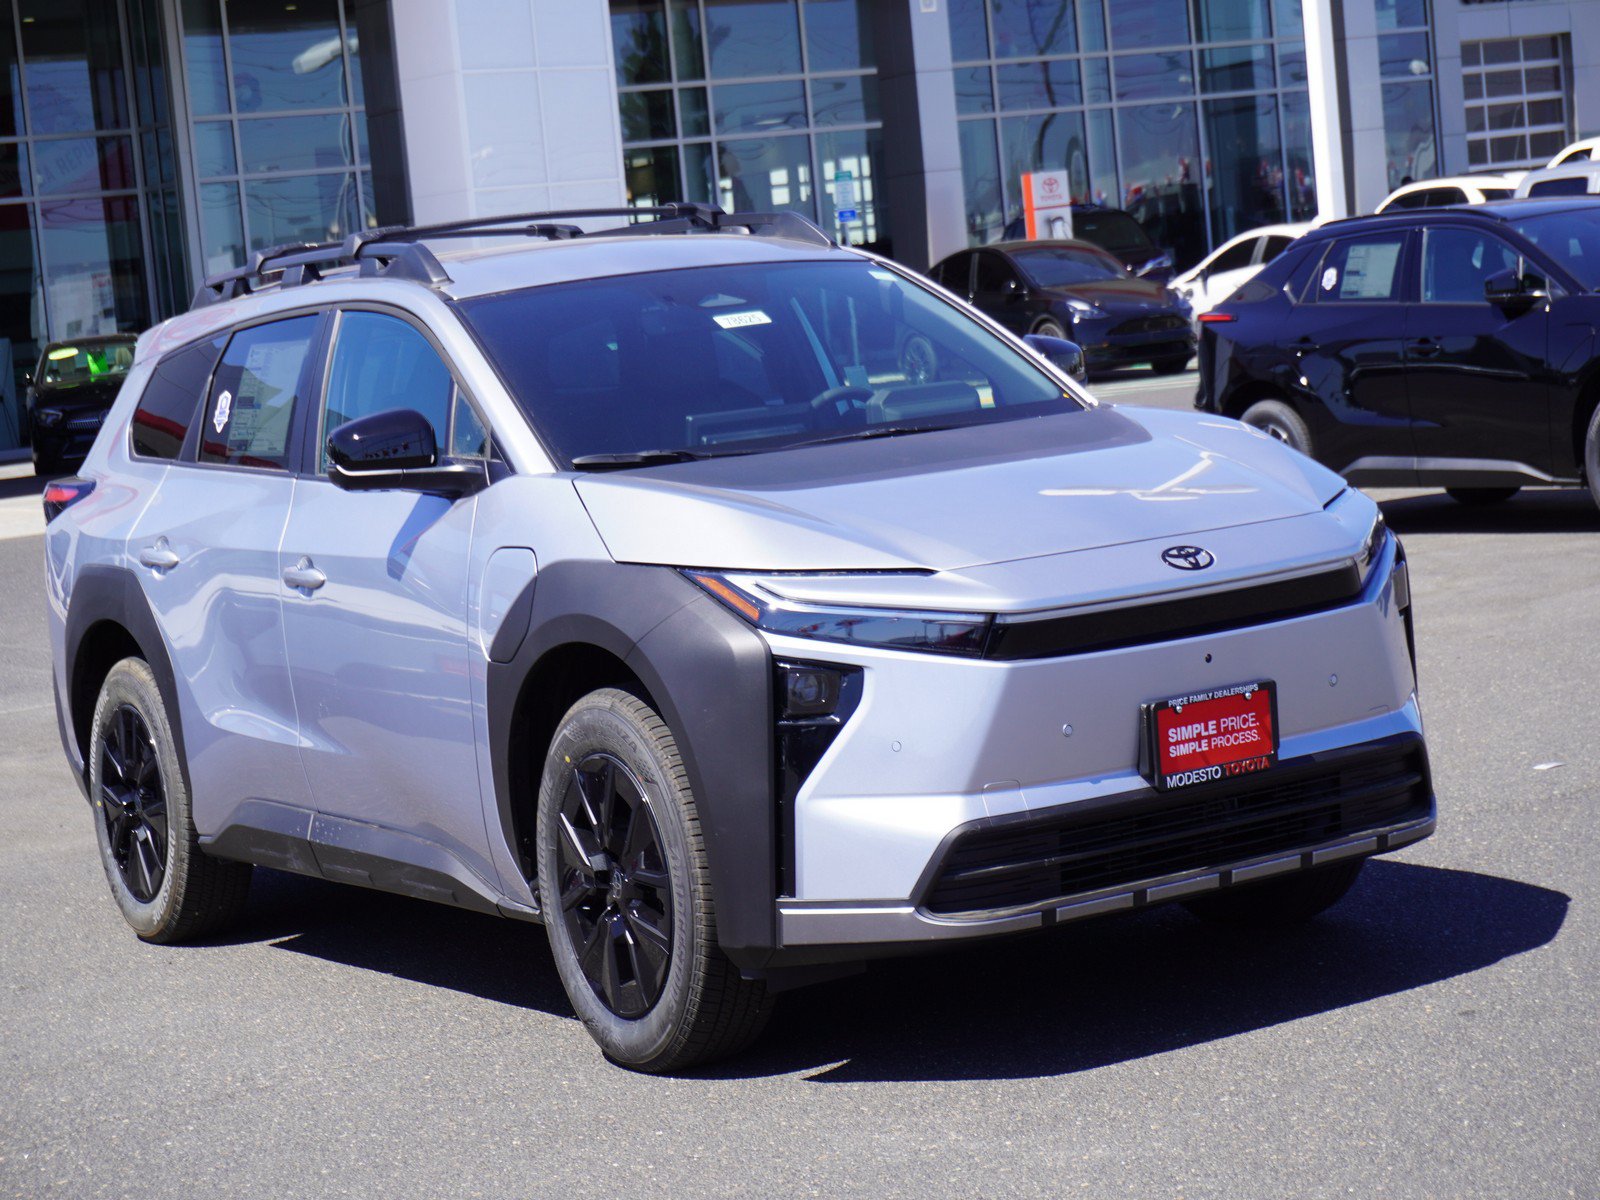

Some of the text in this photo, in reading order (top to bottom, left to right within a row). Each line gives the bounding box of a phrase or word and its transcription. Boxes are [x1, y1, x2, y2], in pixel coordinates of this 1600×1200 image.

[1168, 683, 1259, 708] PRICE FAMILY DEALERSHIPS
[1168, 712, 1260, 743] SIMPLE PRICE.
[1169, 729, 1261, 758] SIMPLE PROCESS.
[1166, 756, 1270, 789] MODESTO TOYOTA
